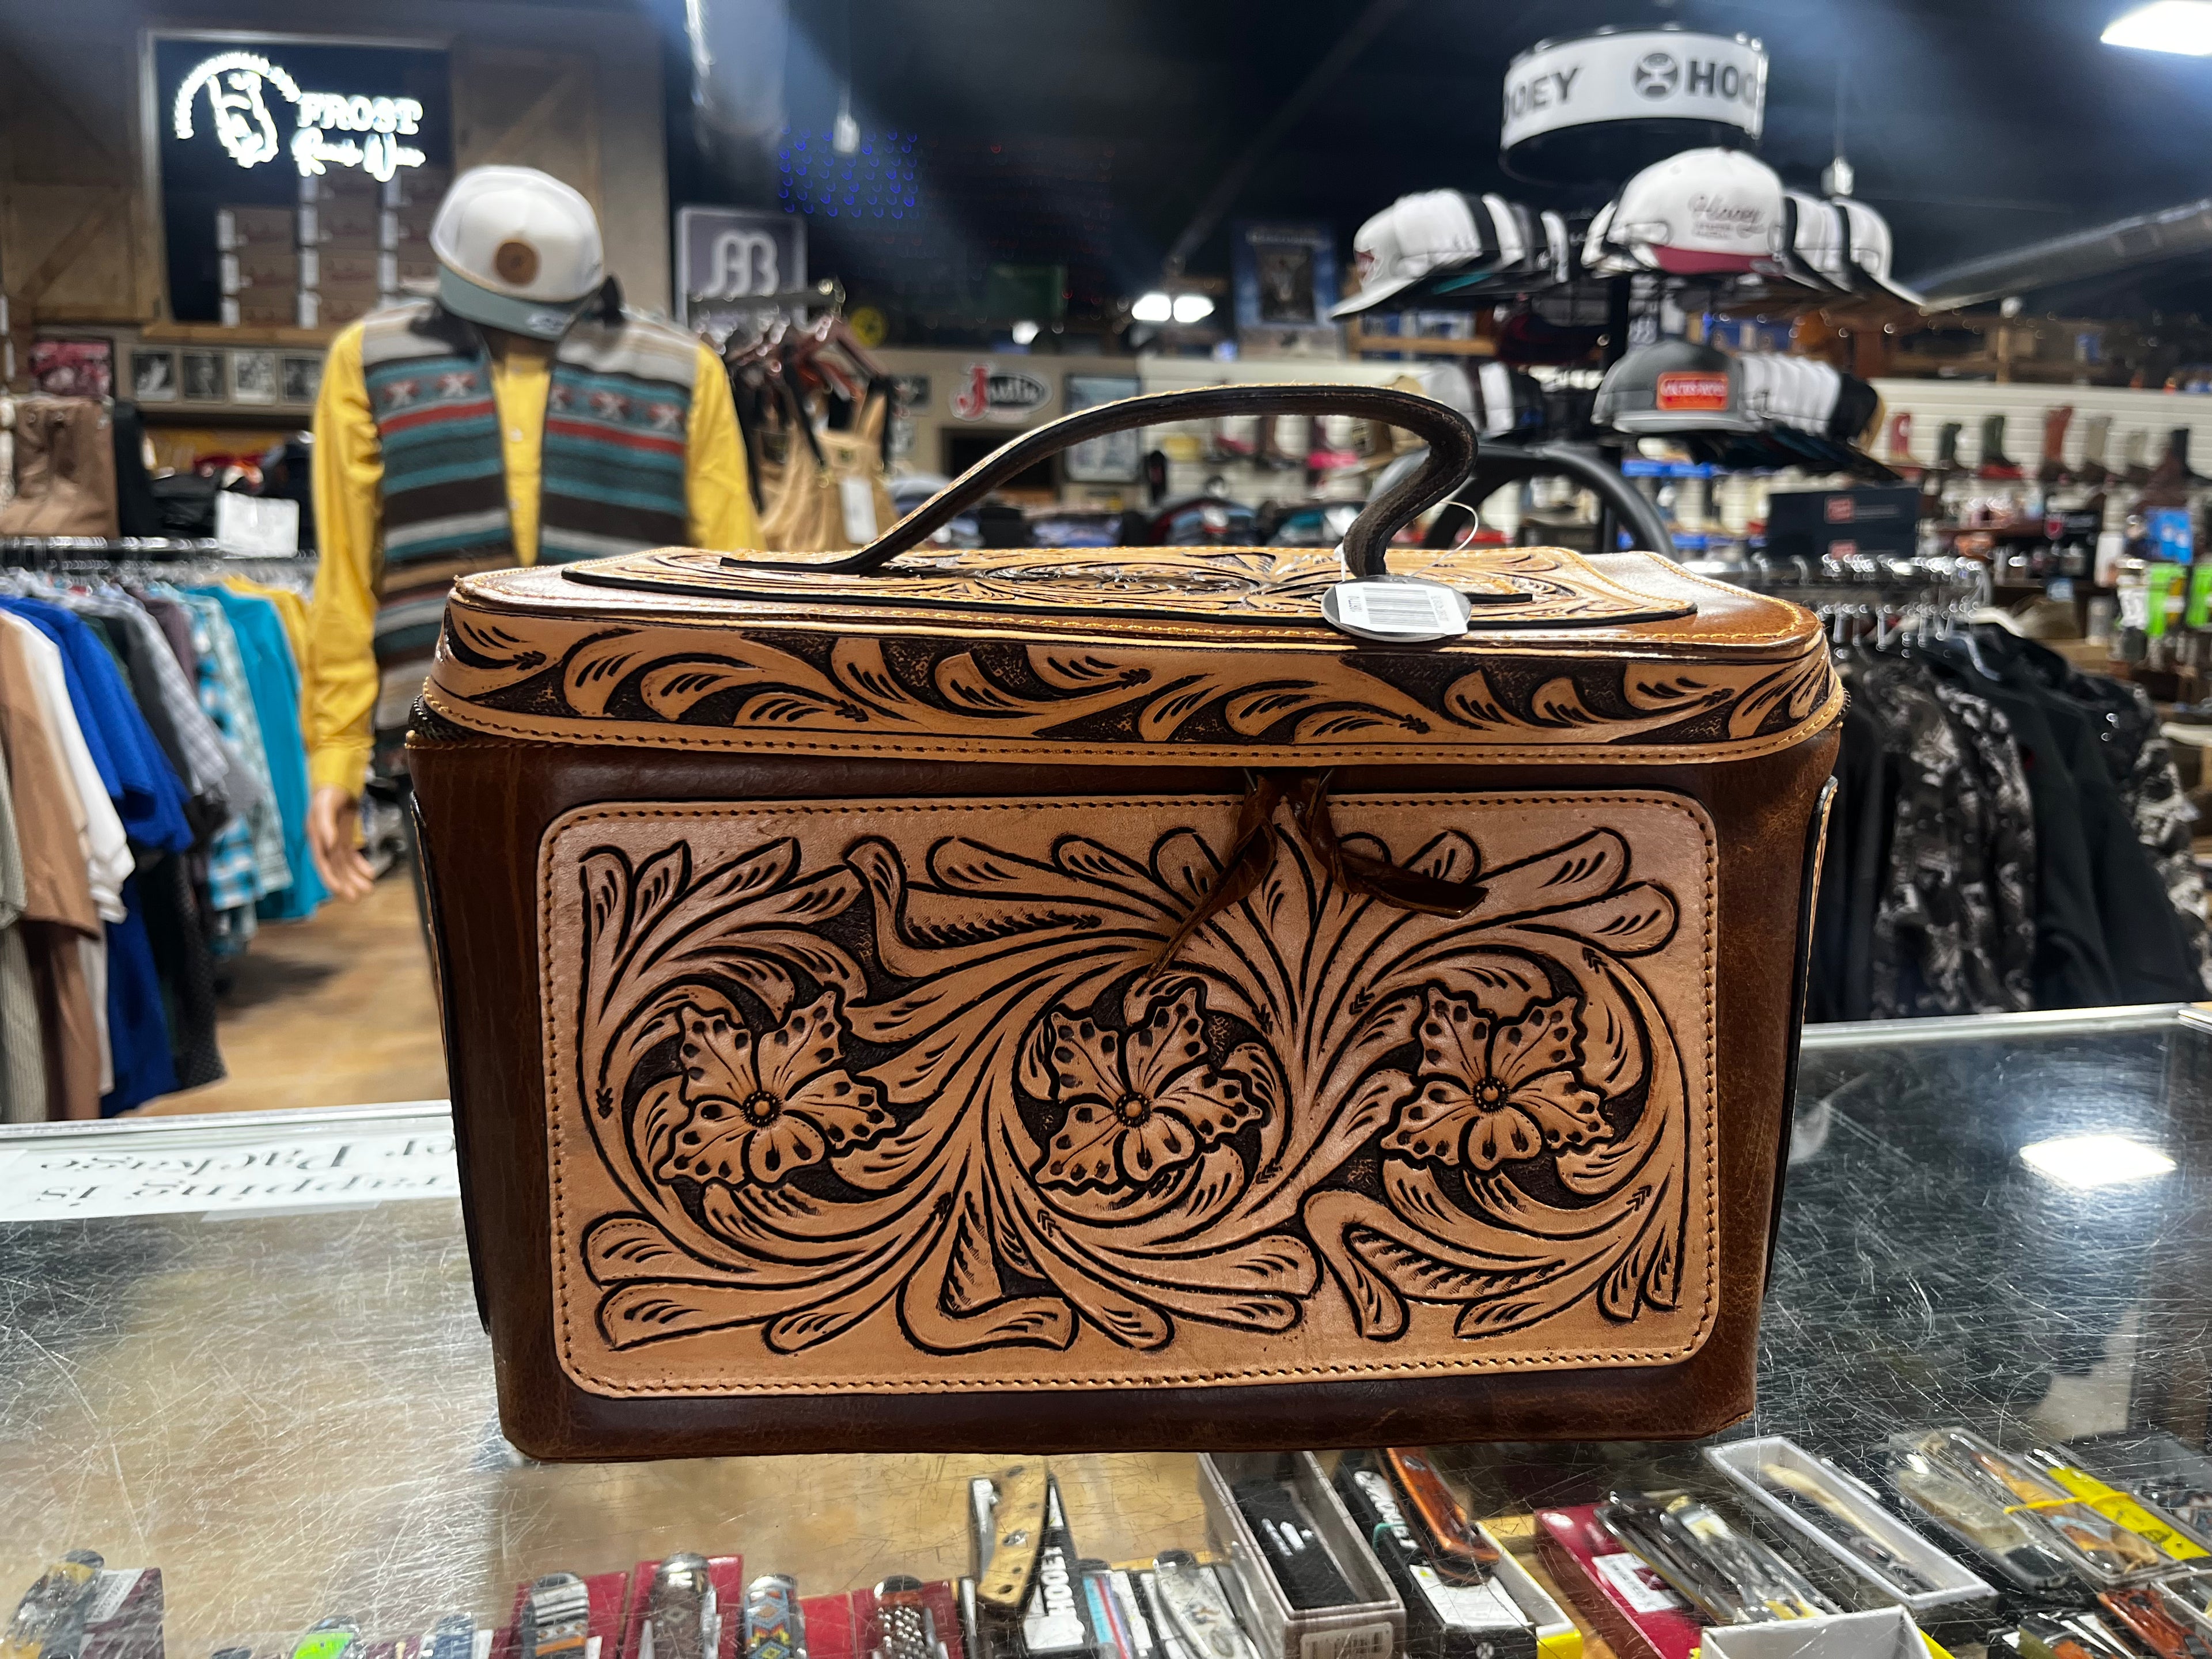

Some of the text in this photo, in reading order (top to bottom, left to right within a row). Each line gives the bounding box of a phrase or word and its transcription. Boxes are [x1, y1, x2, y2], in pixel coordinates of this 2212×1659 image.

[40, 1145, 353, 1176] Package
[36, 1175, 454, 1207] rapping is
